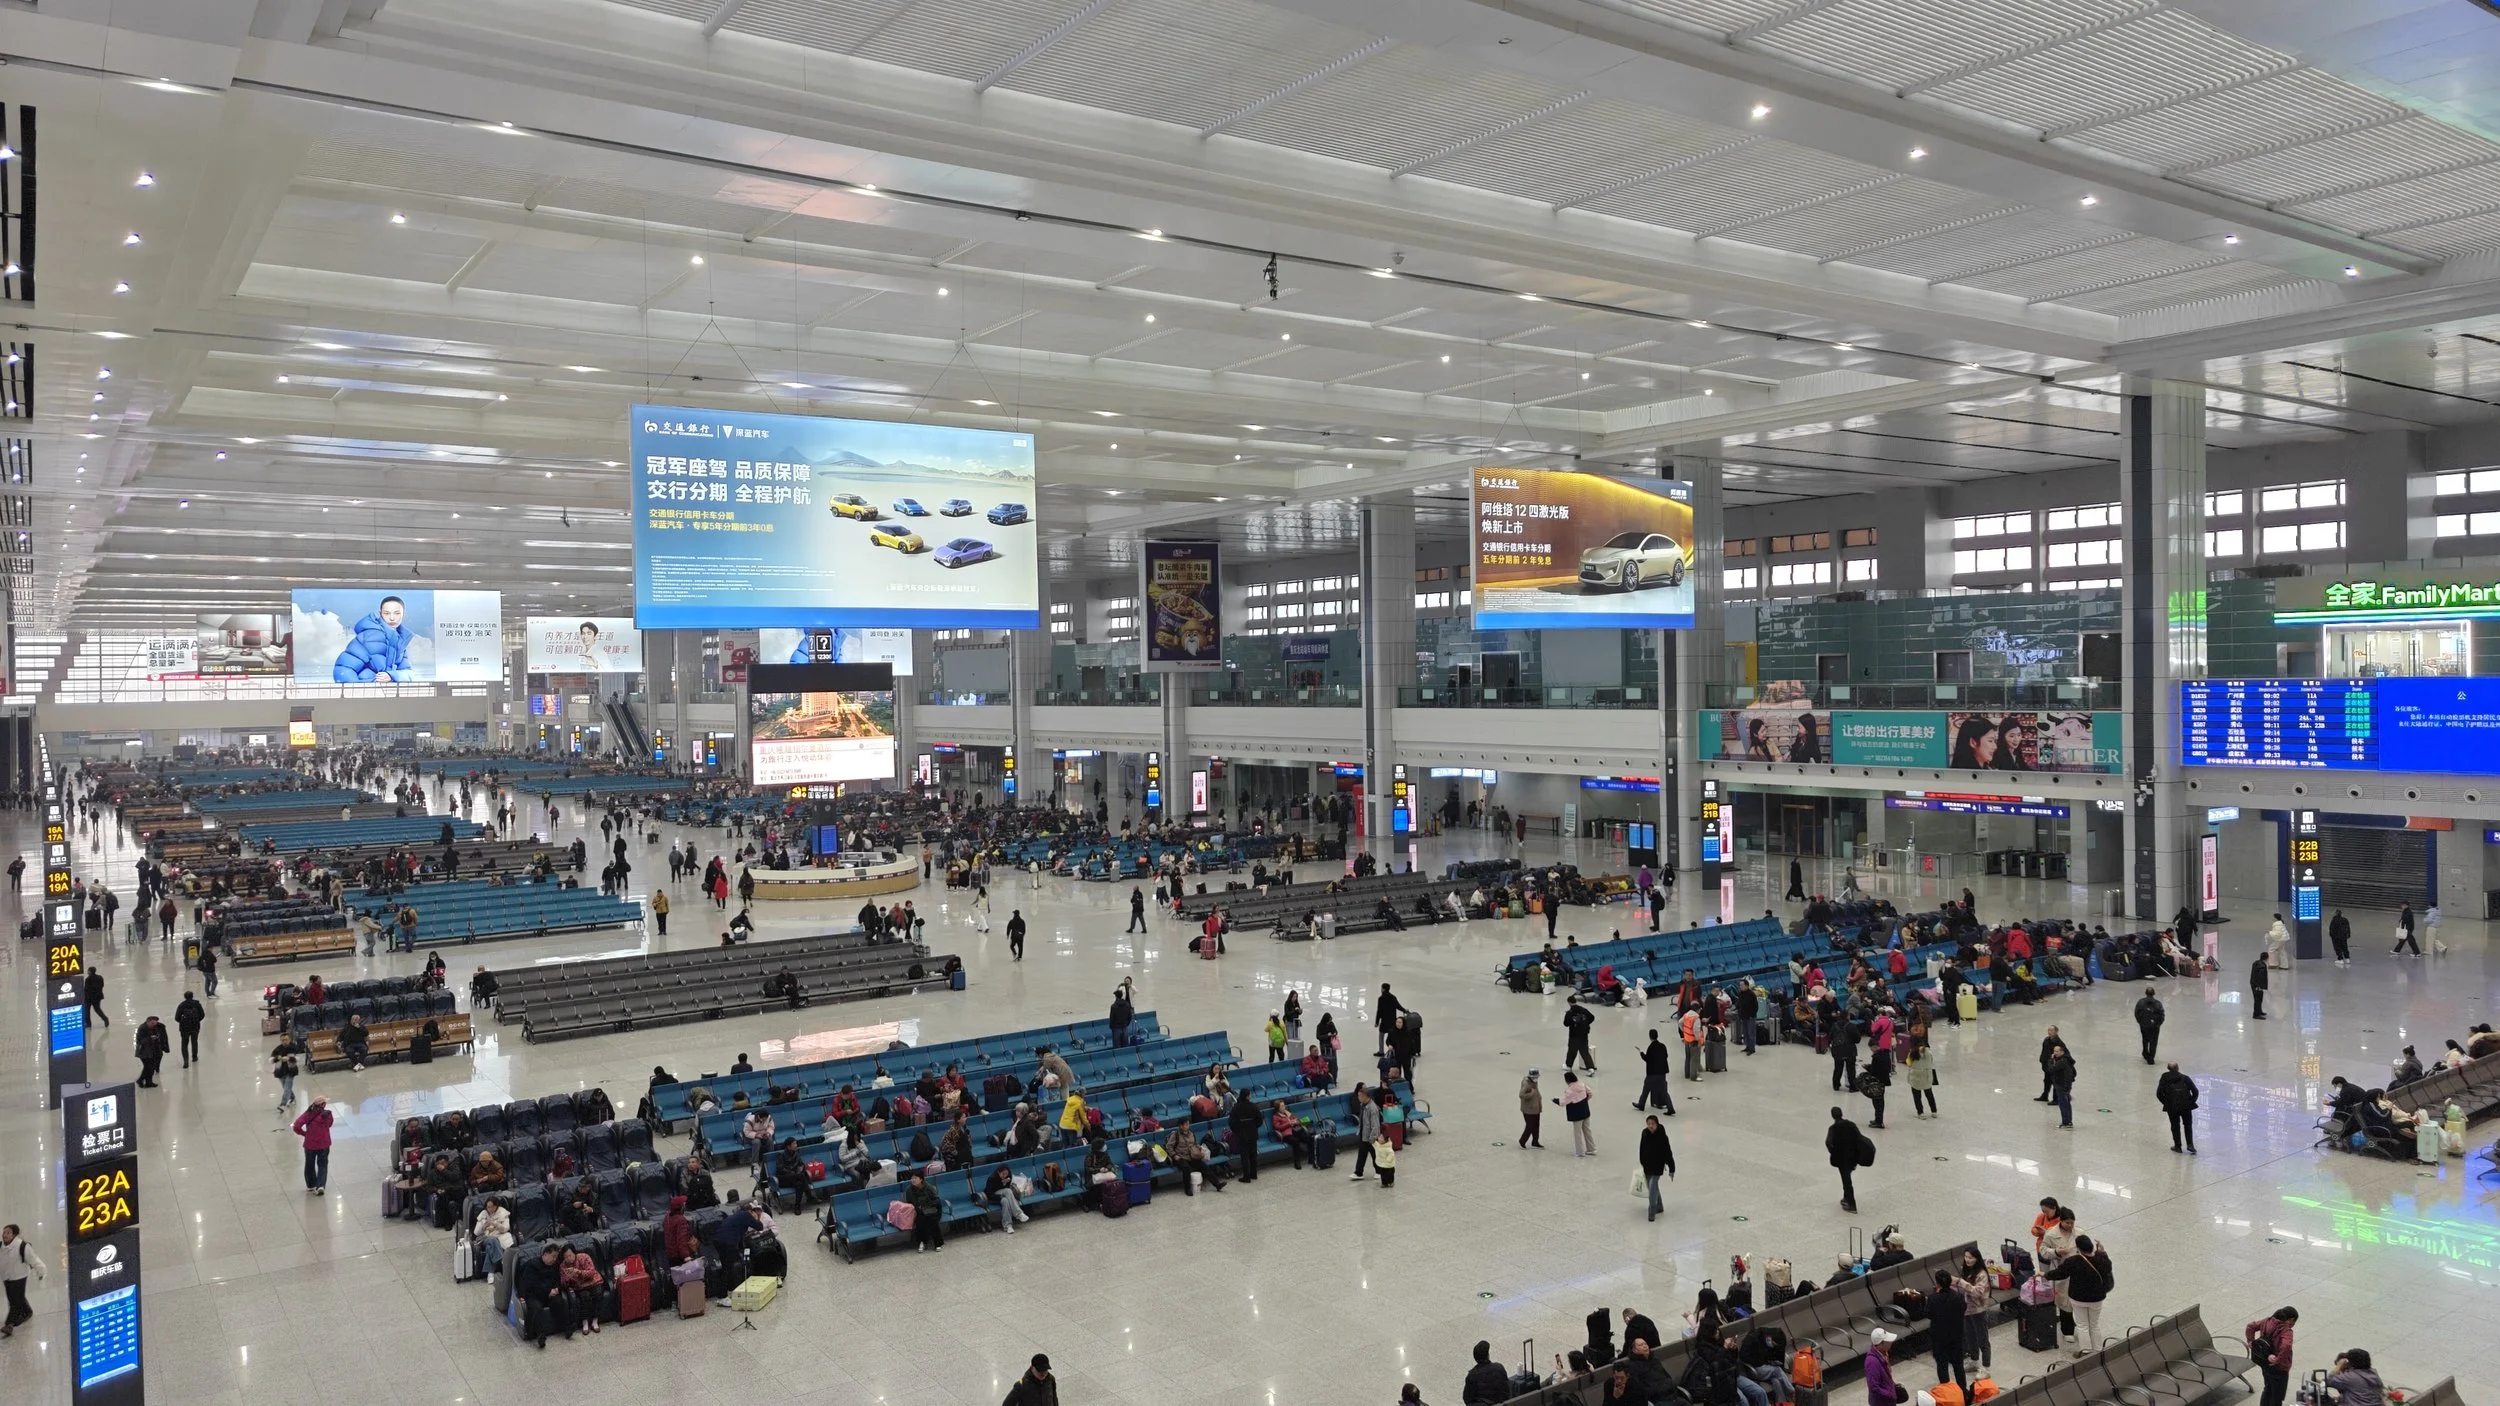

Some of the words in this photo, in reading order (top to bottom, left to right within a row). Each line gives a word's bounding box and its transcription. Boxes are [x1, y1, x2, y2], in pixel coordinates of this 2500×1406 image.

[735, 428, 770, 438] 深蓝汽车
[647, 455, 727, 478] 冠军座驾
[735, 461, 811, 482] 品质保障
[647, 480, 728, 501] 交行分期
[735, 483, 812, 505] 全程护航
[649, 509, 735, 519] 交通银行信用卡车分期
[1481, 502, 1513, 517] 阿维塔
[1515, 504, 1527, 516] 12
[1529, 504, 1569, 520] 四激光版
[1482, 520, 1523, 534] 焕新上市
[1483, 542, 1551, 553] 交通银行信用卡车分期
[1483, 554, 1520, 565] 五年分期前
[1522, 556, 1527, 564] 2
[1530, 556, 1551, 565] 年免息
[2326, 582, 2376, 606] 全家
[149, 651, 185, 659] 全国货运
[545, 645, 583, 655] 可信赖的
[603, 645, 630, 654] 健康美
[2457, 691, 2466, 700] 公
[1842, 724, 1936, 739] 让您的出行更美好
[1703, 802, 1718, 811] 20B
[47, 826, 63, 834] 16A
[2299, 841, 2318, 851] 22B
[2299, 851, 2319, 861] 23B
[48, 872, 69, 882] 18A
[48, 882, 69, 892] 19A
[53, 922, 76, 931] 检票口
[51, 944, 80, 959] 20A
[51, 958, 80, 974] 21A
[82, 1127, 125, 1148] 检票口
[82, 1146, 103, 1157] Ticket
[103, 1142, 124, 1152] Check
[78, 1169, 131, 1203] 22A
[79, 1196, 131, 1231] 23A
[91, 1262, 123, 1280] 重庆车站
